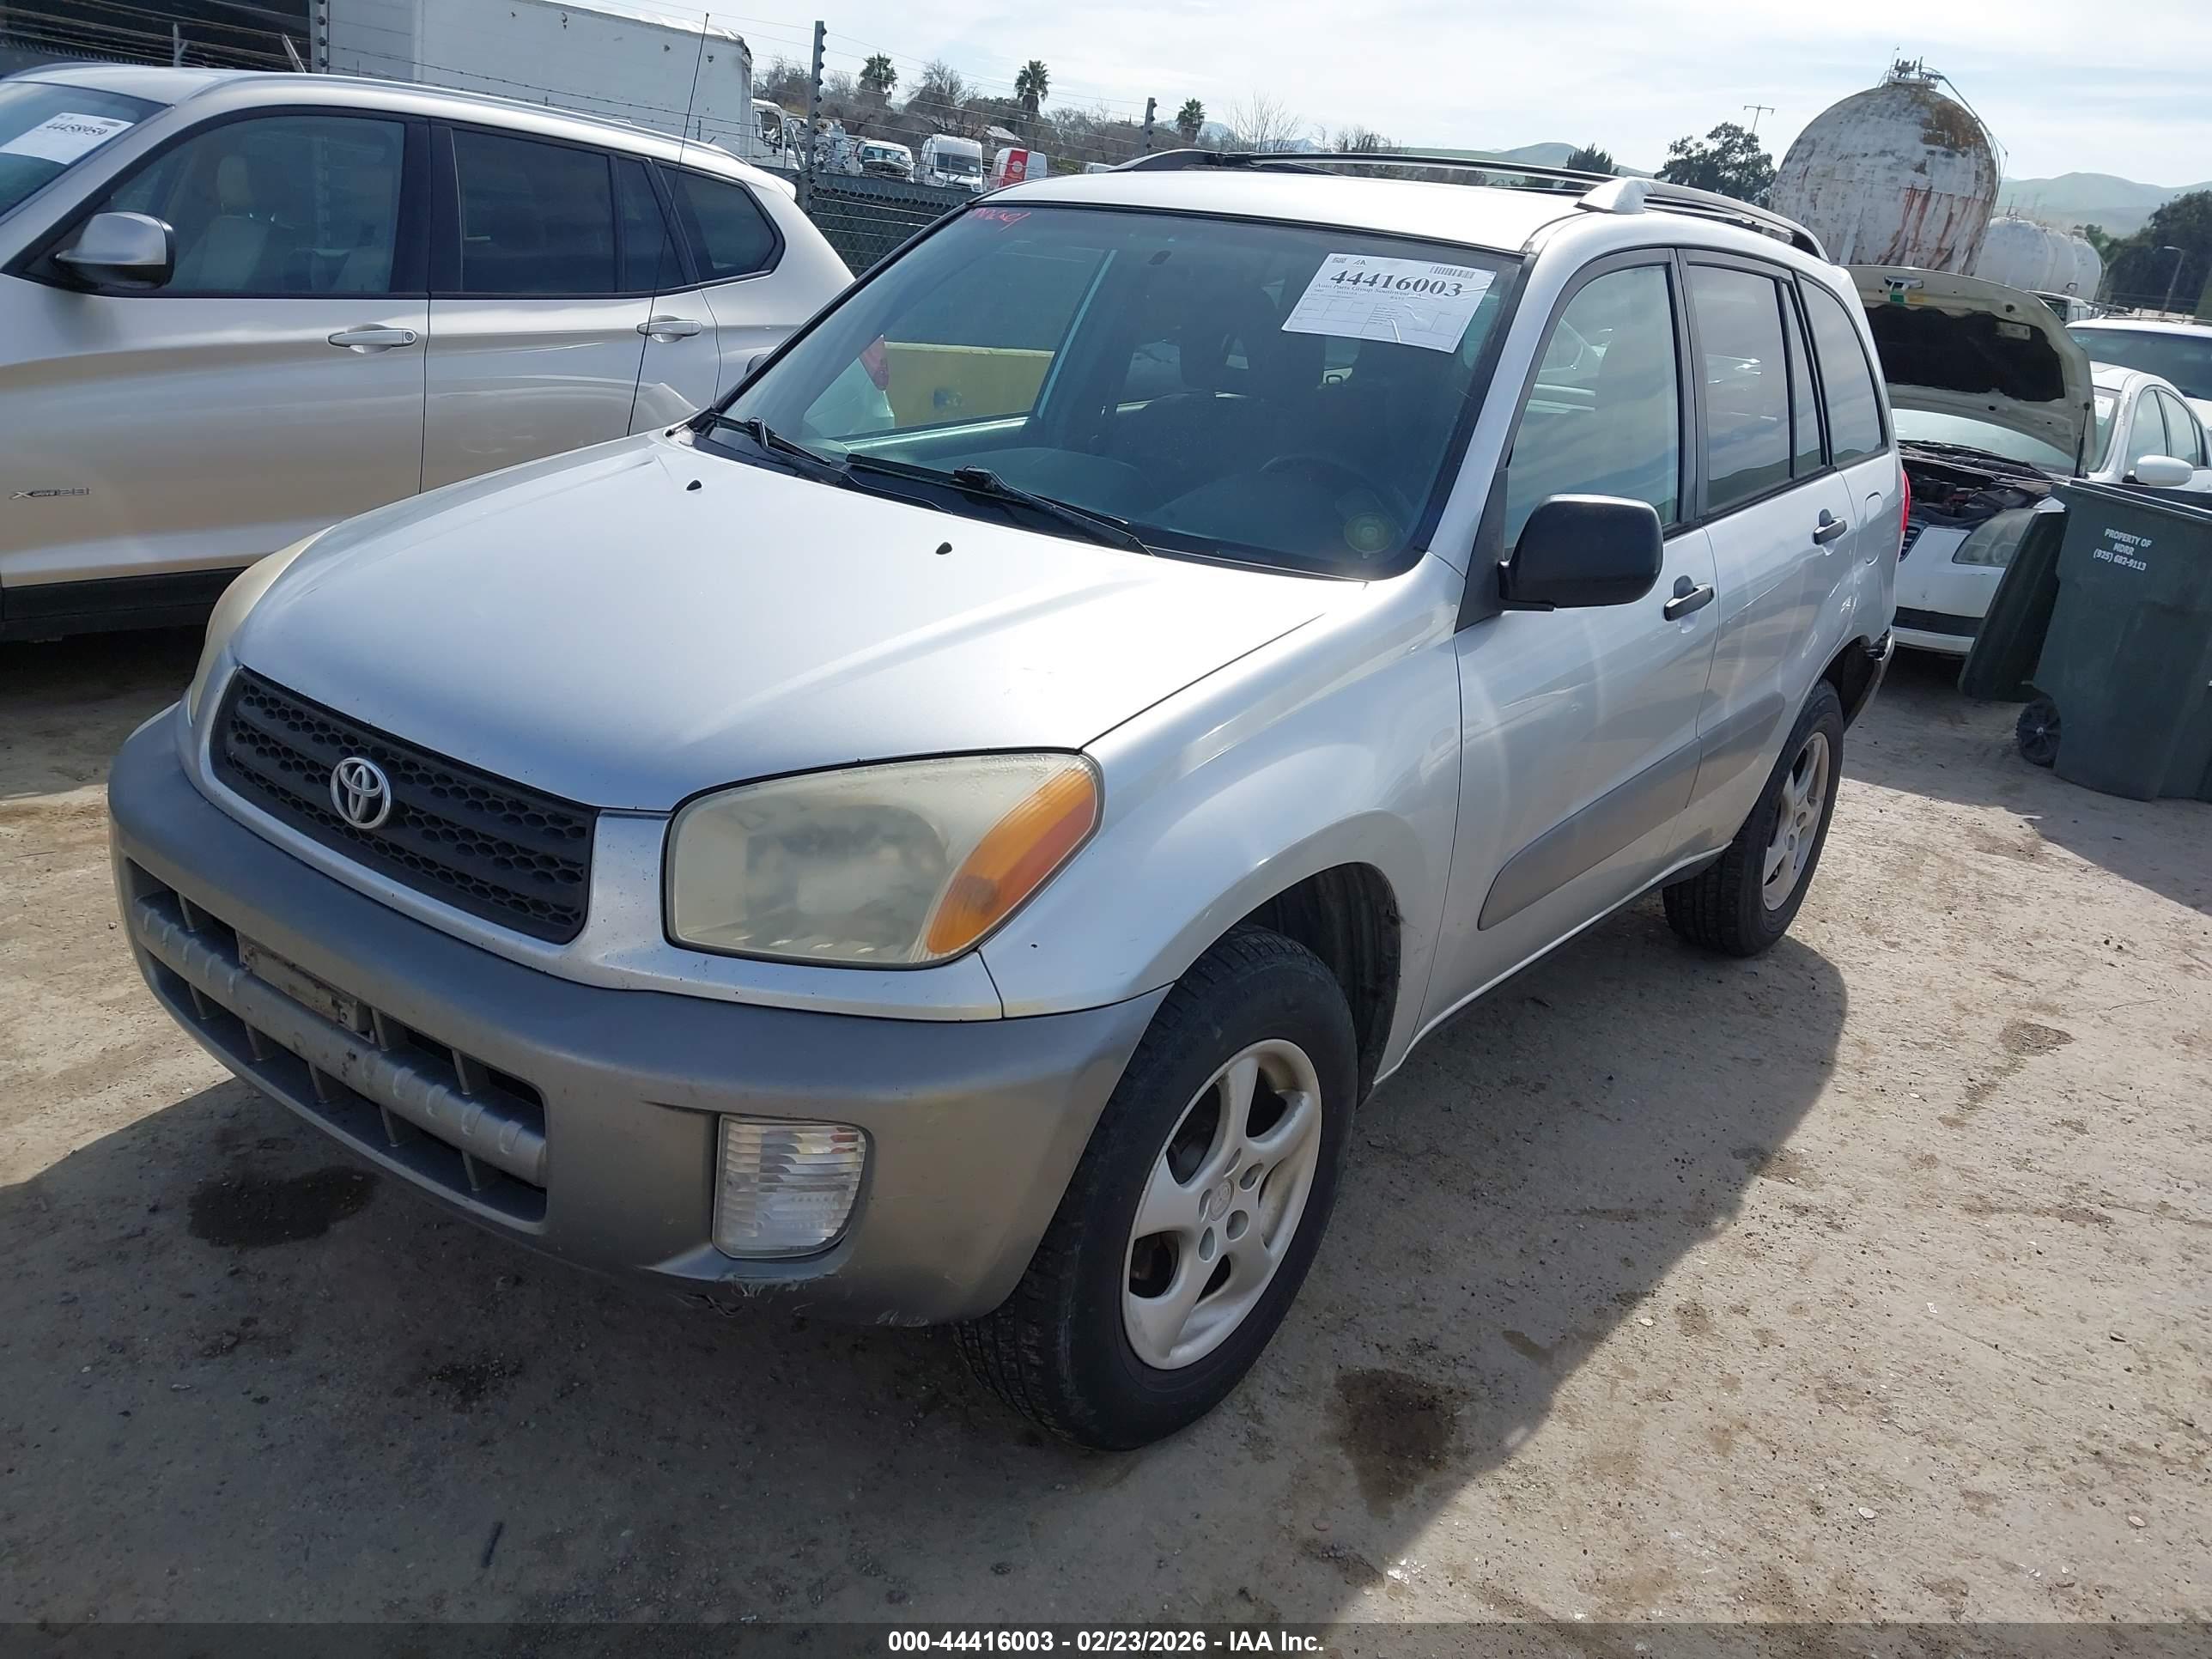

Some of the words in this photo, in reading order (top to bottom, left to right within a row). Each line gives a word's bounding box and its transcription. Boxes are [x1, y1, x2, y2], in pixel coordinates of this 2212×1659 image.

[1330, 270, 1463, 297] 44416003
[2105, 528, 2141, 545] PROPERTY
[2140, 538, 2152, 548] OF
[2094, 549, 2113, 562] (925)
[2113, 555, 2147, 571] 682-9113
